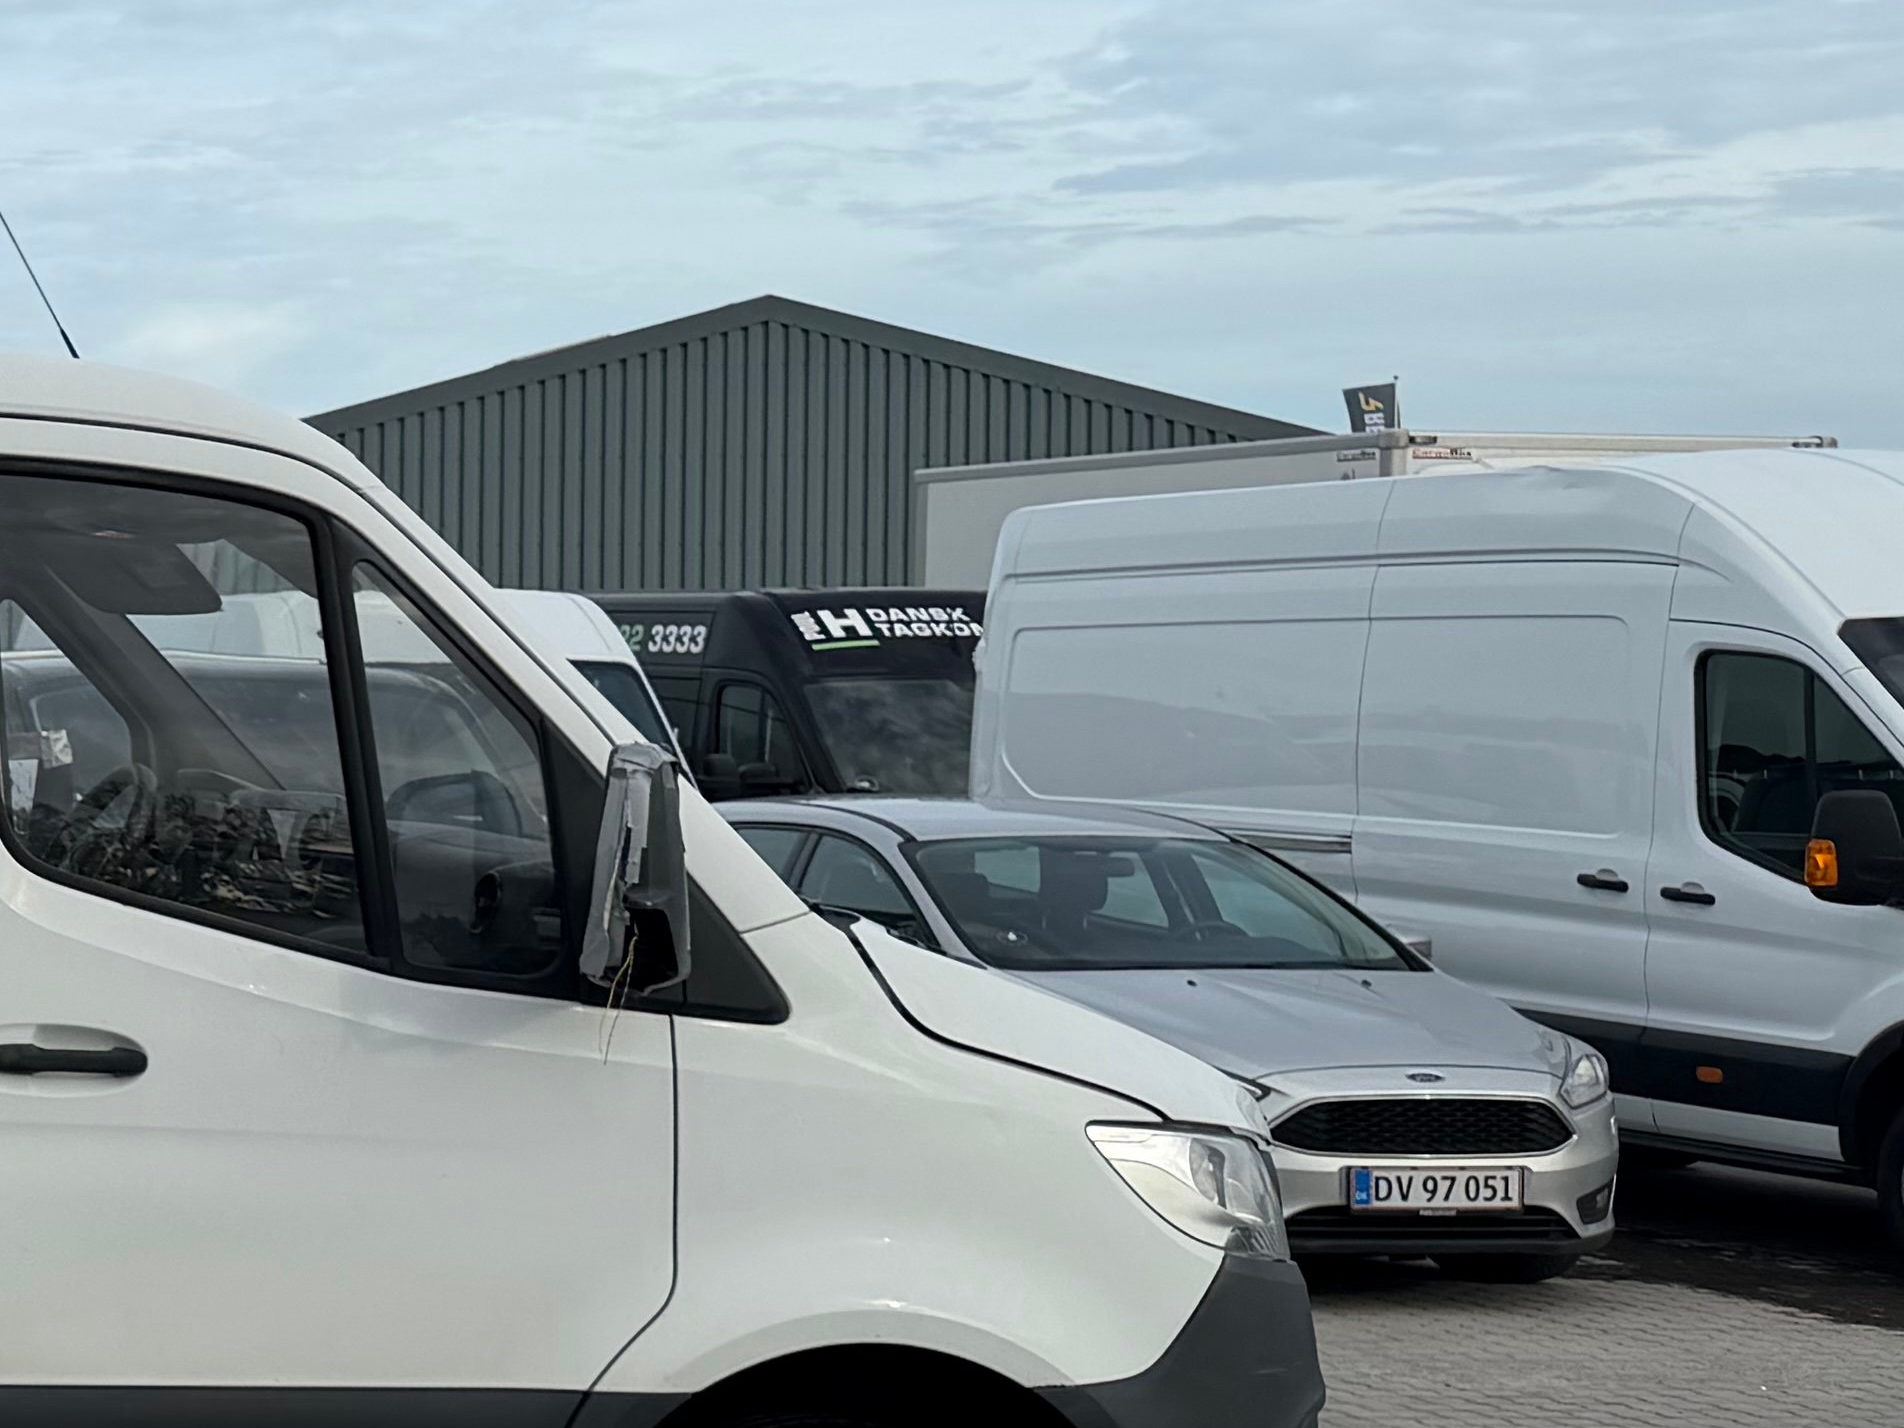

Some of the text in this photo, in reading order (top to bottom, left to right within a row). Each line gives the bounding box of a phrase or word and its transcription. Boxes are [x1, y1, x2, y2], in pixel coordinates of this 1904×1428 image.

[865, 607, 971, 621] DANSK
[648, 624, 707, 654] 3333
[1374, 1175, 1513, 1202] DV 97 051
